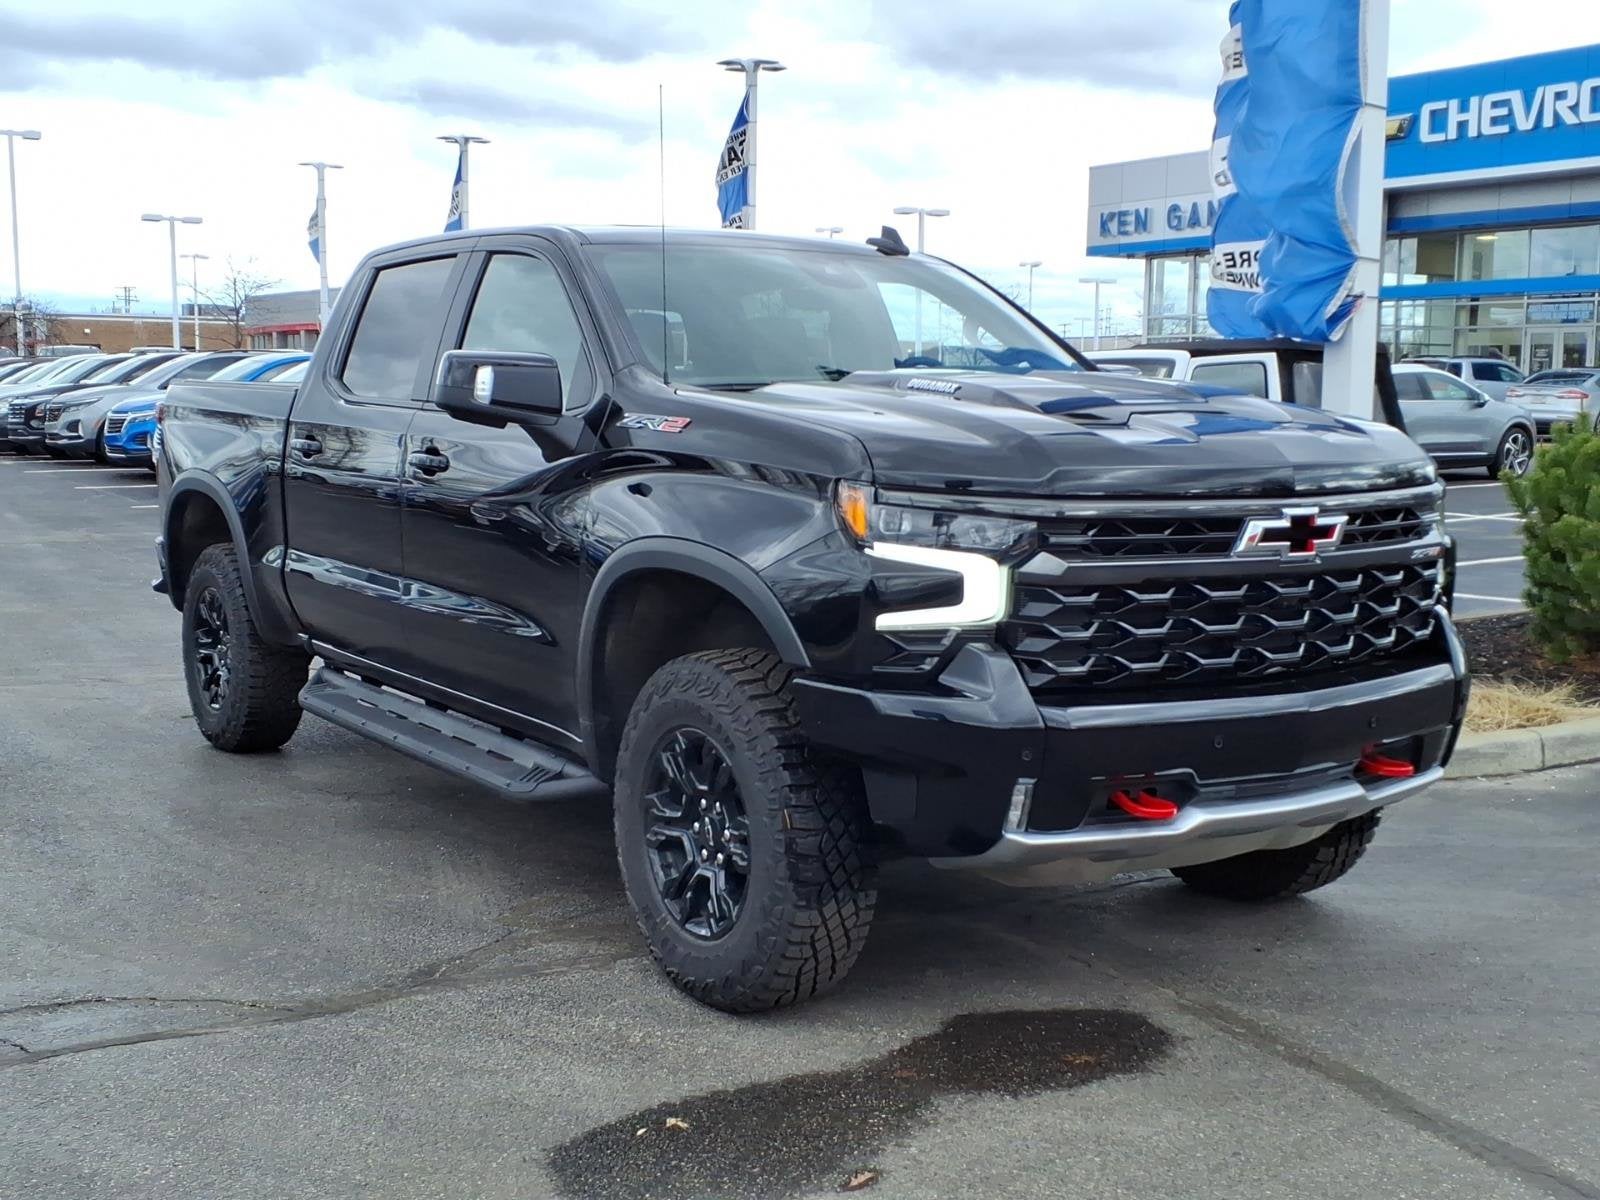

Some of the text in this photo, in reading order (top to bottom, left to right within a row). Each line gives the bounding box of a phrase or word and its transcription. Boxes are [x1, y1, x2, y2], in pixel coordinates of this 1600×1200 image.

[1099, 207, 1150, 238] KEN
[907, 378, 961, 394] DURAMAX
[616, 412, 692, 433] ZR2
